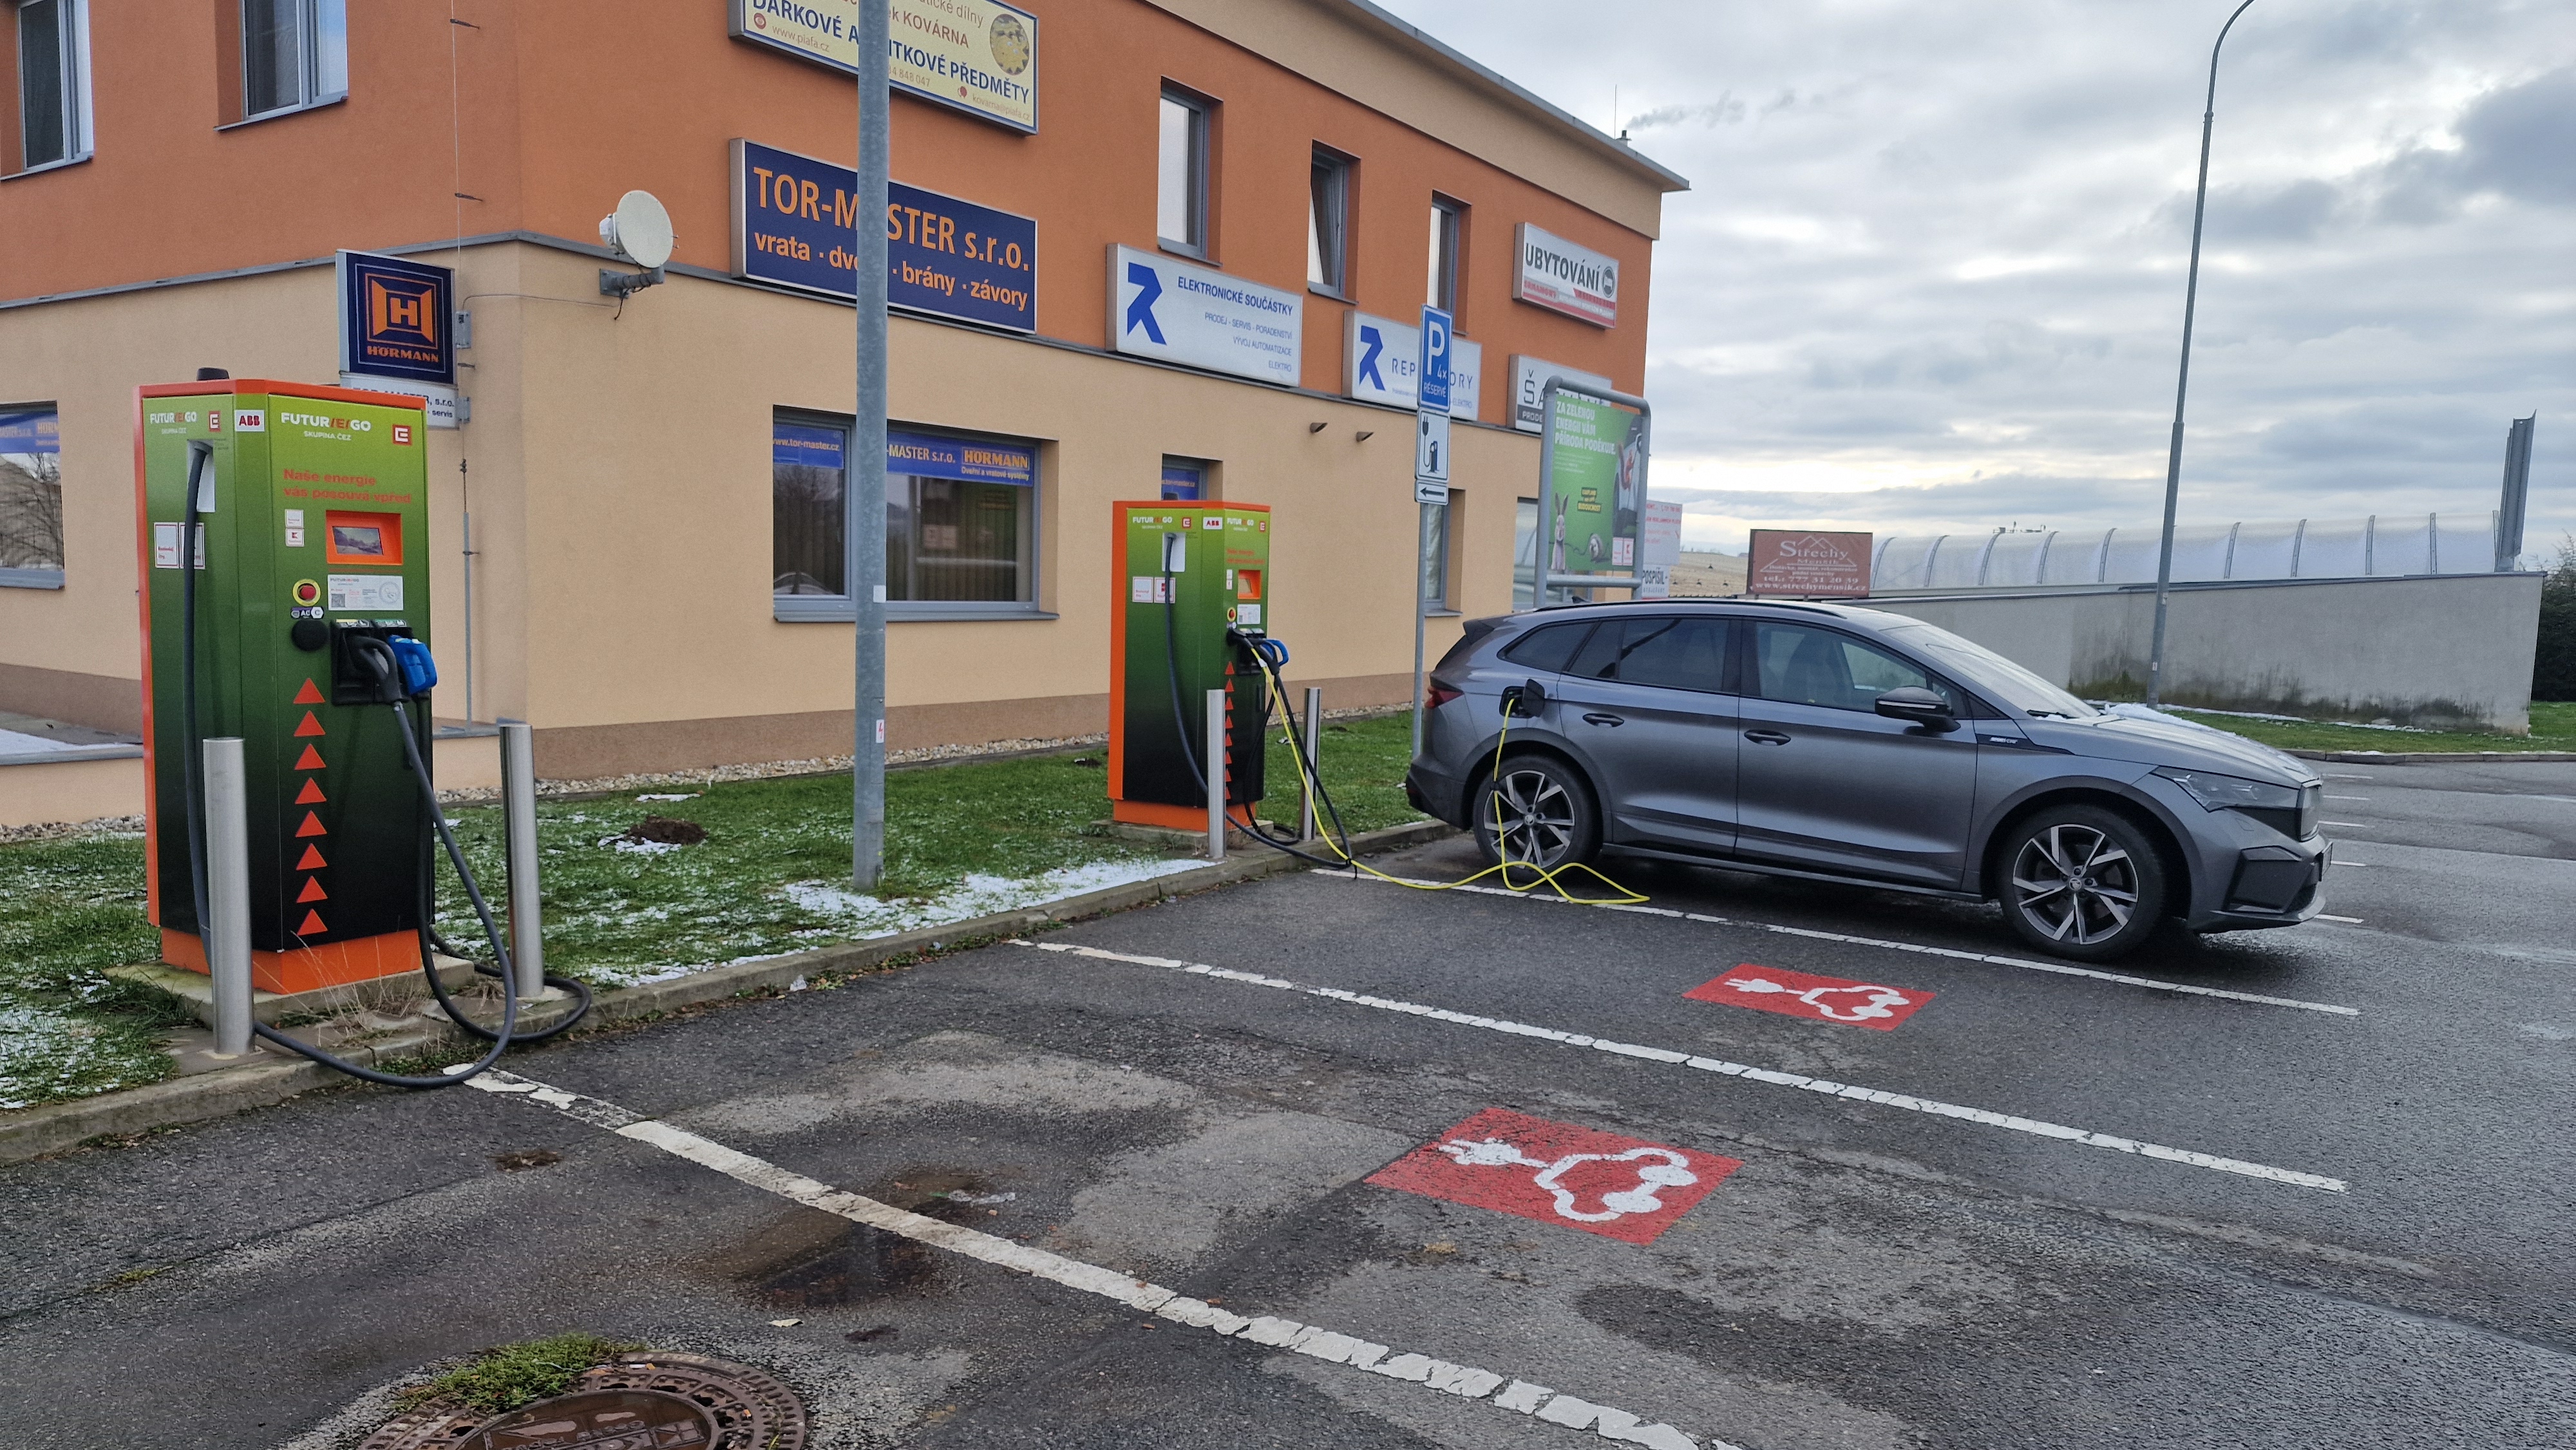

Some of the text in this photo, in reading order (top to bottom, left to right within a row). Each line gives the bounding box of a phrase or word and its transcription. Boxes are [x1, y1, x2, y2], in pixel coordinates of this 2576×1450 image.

[903, 10, 970, 49] KOVÁRNA
[956, 4, 983, 28] dílny
[772, 25, 830, 53] www.piafa.cz
[889, 39, 947, 76] ITKOVÉ
[949, 61, 1030, 104] PŘEDMĚTY
[753, 166, 1030, 272] TOR-MSTER s.r.o.
[754, 232, 811, 261] vrata
[902, 260, 956, 296] brány
[971, 278, 1028, 312] závory
[1525, 242, 1600, 292] UBYTOVÁNÍ
[1178, 276, 1293, 317] ELEKTRONICKÉ SOUČÁSTKY
[1205, 312, 1293, 340] PRODEJ SERVIS PORADENSTVÍ
[1426, 321, 1446, 376] P
[1269, 360, 1292, 373] ELEKTRO
[1392, 358, 1473, 390] REPORY
[432, 410, 453, 418] servis
[435, 398, 455, 408] s.r.o.
[1522, 410, 1543, 422] PRODE
[238, 415, 260, 426] ABB
[887, 444, 956, 463] -MASTER s.r.o.
[283, 469, 376, 487] Naše energie
[283, 486, 308, 497] vás
